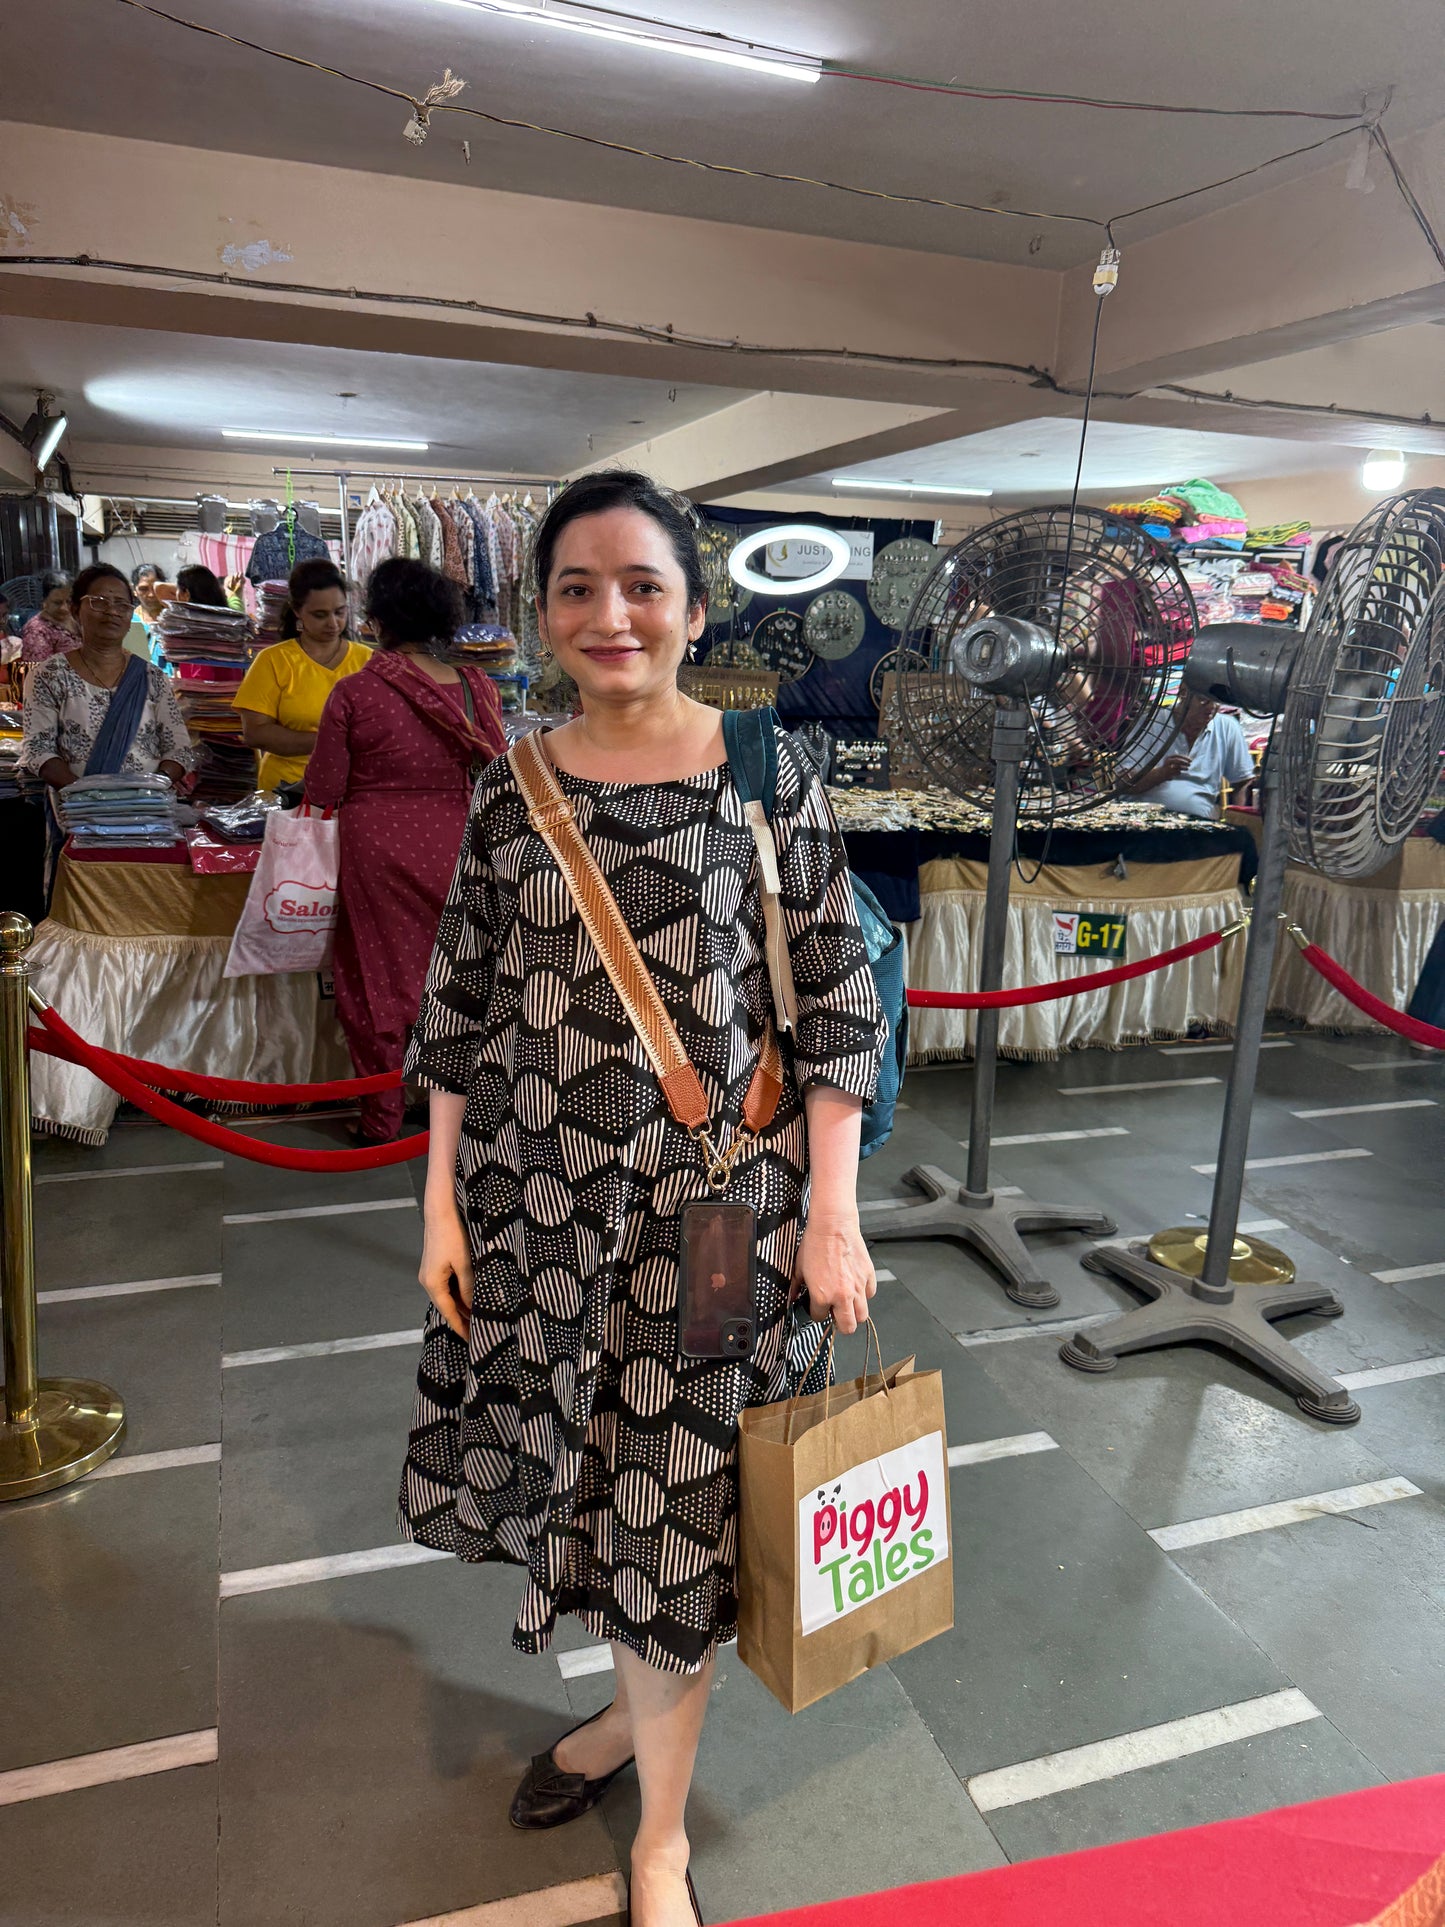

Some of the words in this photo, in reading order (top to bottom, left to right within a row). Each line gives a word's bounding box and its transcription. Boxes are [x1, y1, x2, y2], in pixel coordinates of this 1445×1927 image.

[797, 544, 827, 556] JUST
[1077, 921, 1125, 949] G-17
[818, 1529, 935, 1613] Tales
